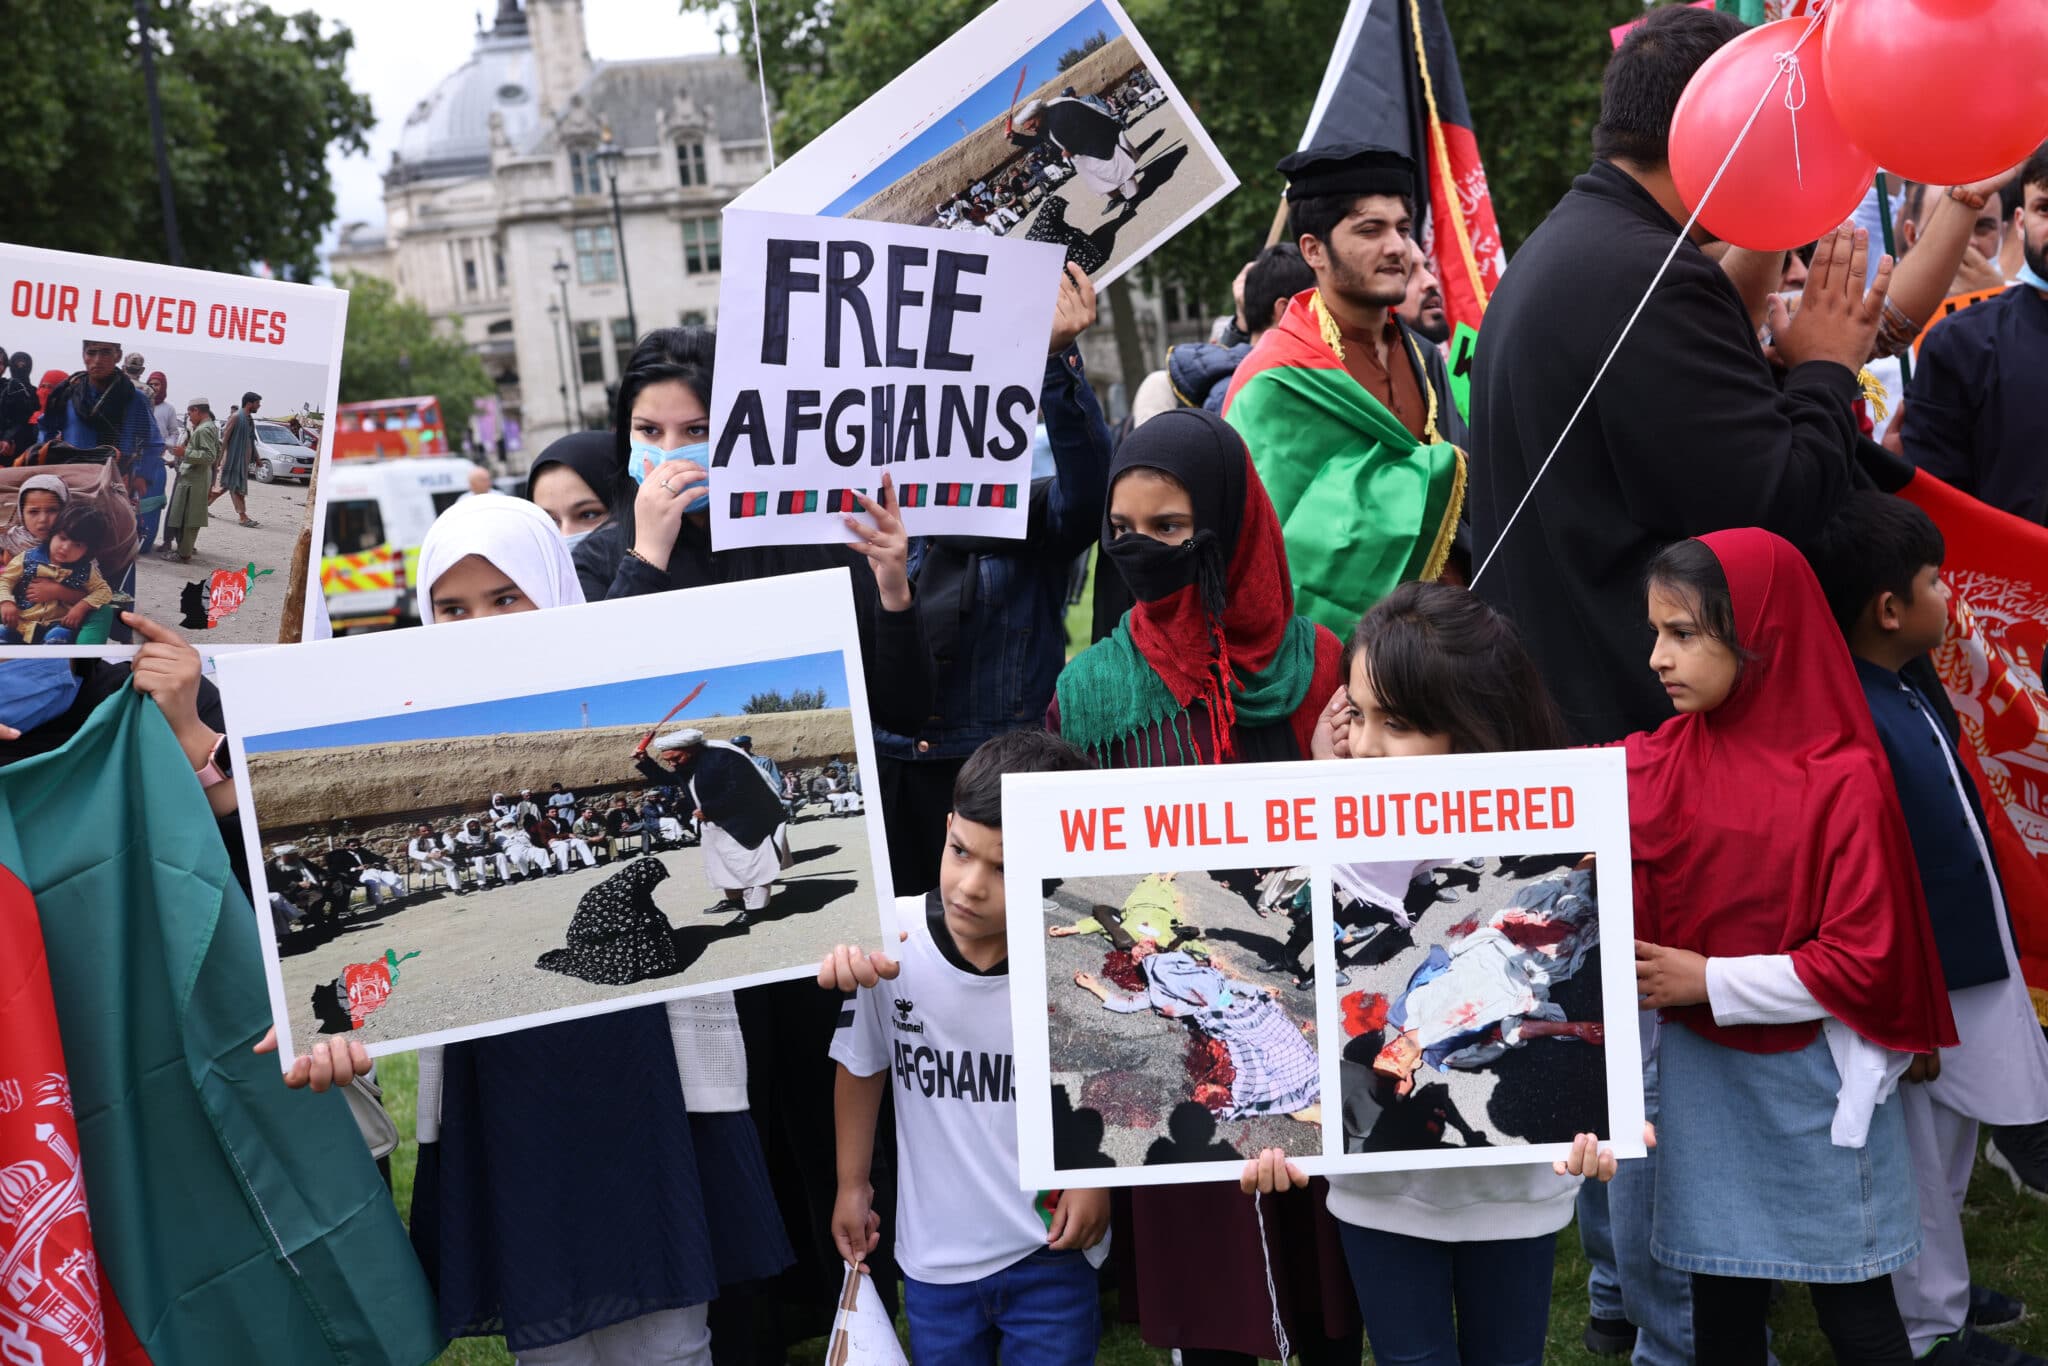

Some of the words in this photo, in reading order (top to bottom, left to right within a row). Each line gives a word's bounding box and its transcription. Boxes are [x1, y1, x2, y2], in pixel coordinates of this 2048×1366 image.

[11, 279, 80, 323] OUR
[91, 289, 197, 335] LOVED
[208, 303, 287, 346] ONES
[761, 238, 989, 372] FREE
[711, 384, 1036, 468] AFGHANS
[1060, 807, 1127, 853] WE
[1144, 801, 1249, 849] WILL
[1265, 797, 1318, 843] BE
[1335, 785, 1575, 840] BUTCHERED
[894, 1038, 1016, 1103] AFGHANI
